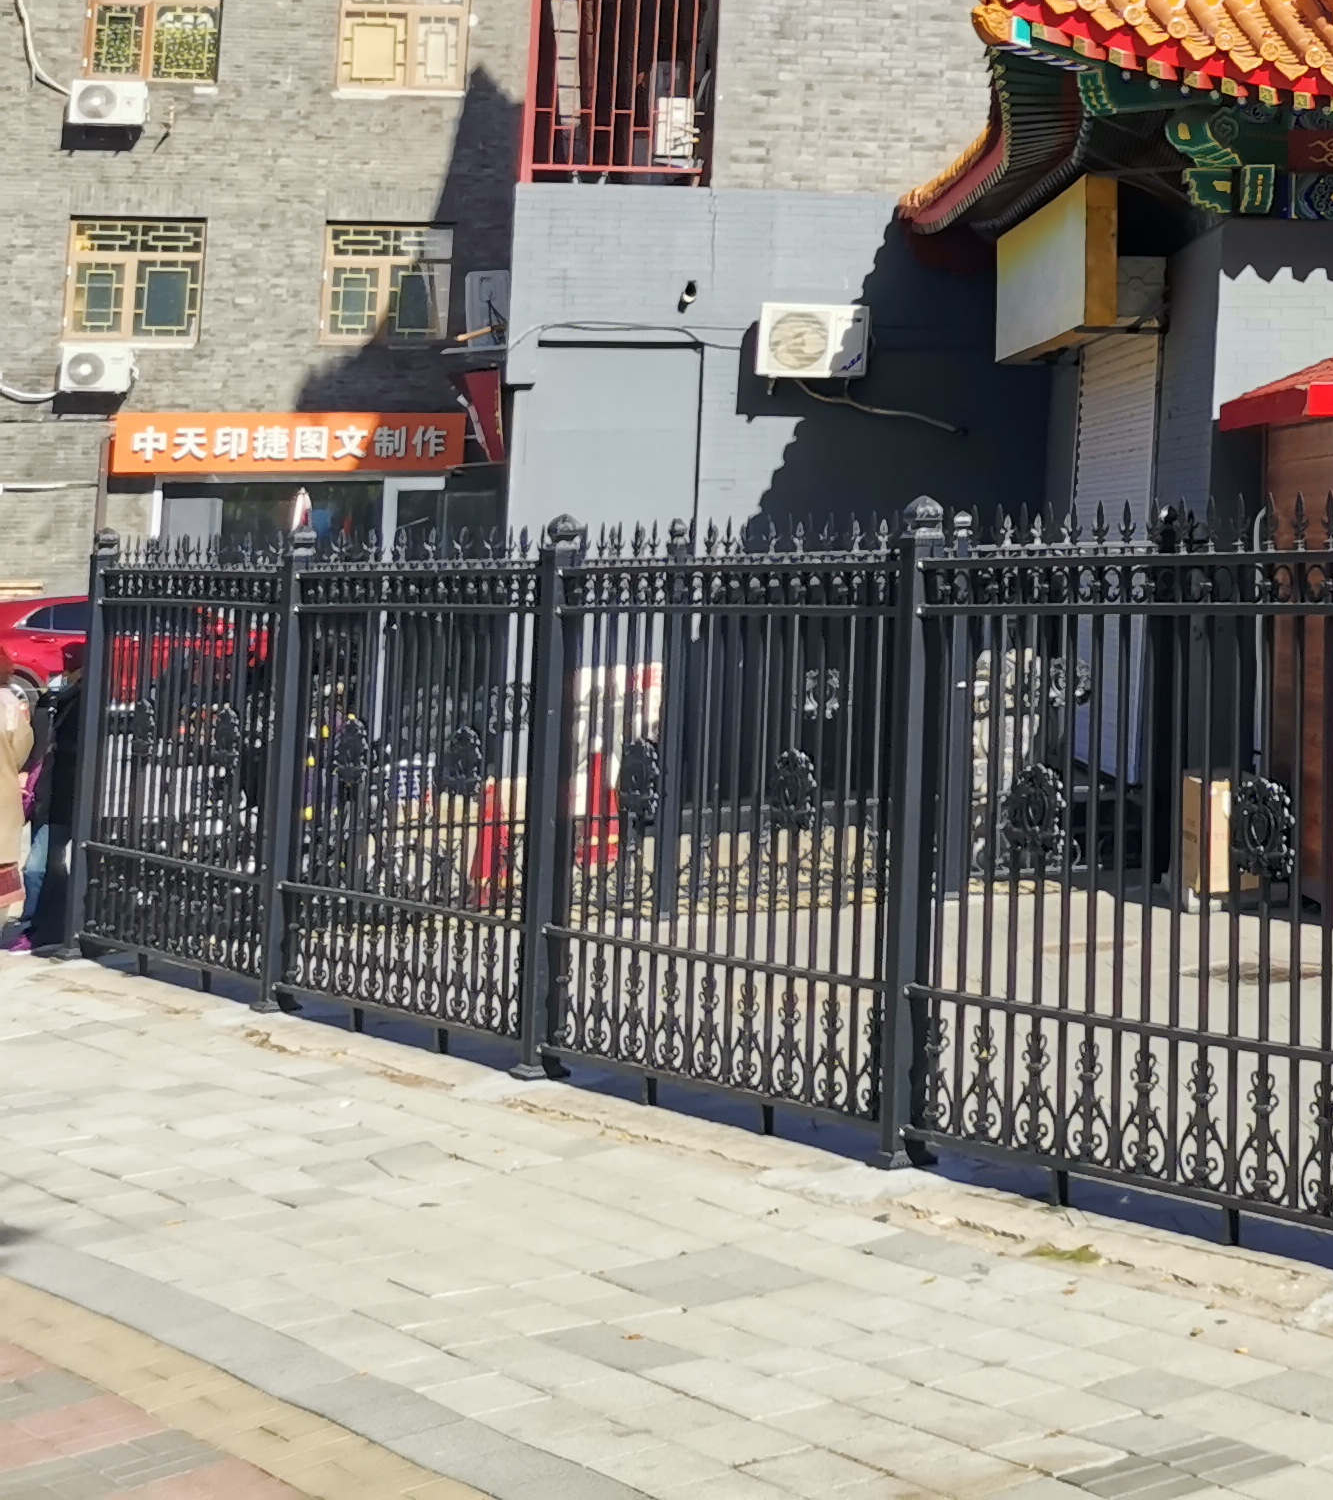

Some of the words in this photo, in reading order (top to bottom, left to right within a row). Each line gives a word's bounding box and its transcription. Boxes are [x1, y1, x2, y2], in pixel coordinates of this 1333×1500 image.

[132, 425, 449, 462] 中天印捷图文制作
